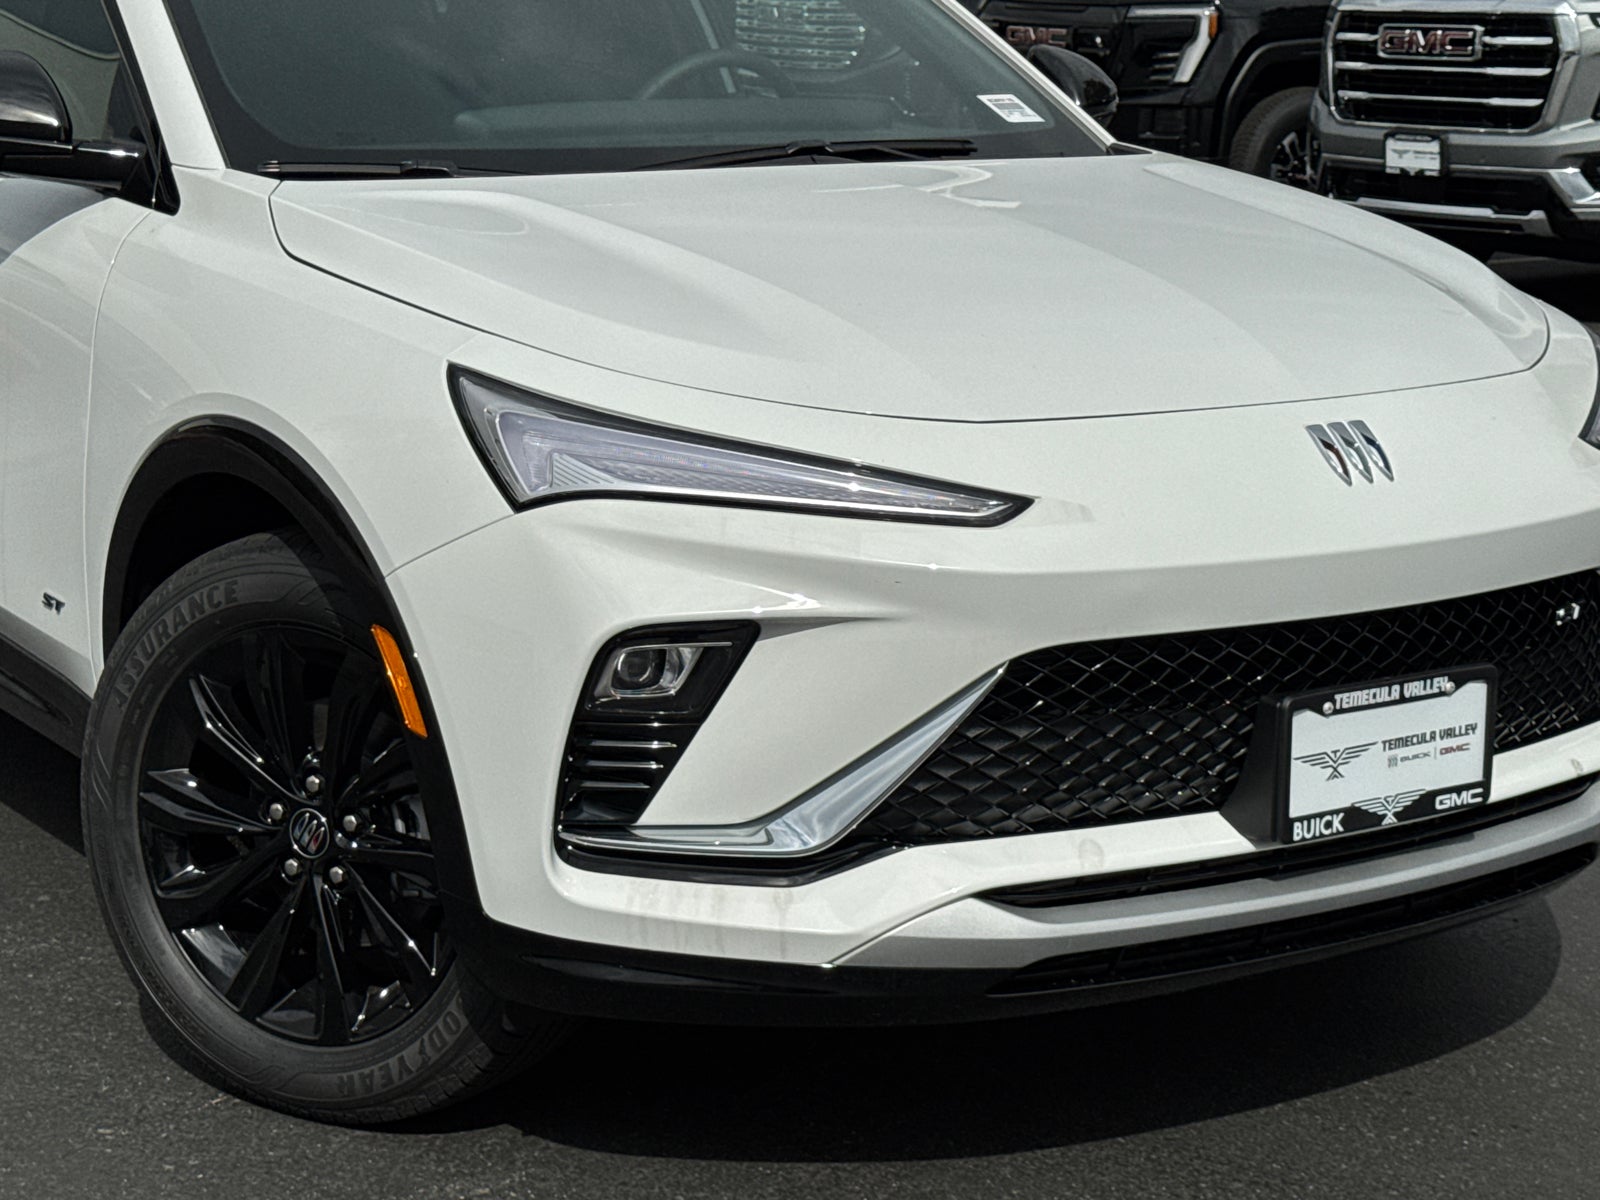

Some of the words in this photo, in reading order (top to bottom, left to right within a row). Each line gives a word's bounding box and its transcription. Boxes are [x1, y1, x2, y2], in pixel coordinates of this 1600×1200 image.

[1006, 25, 1067, 46] GMC
[1381, 29, 1473, 54] GMC
[115, 580, 239, 708] ASSURANCE
[1334, 685, 1400, 710] TEMECULA
[1403, 676, 1449, 699] VALLEY
[1381, 730, 1437, 752] TEMECULA
[1439, 722, 1478, 742] VALLEY
[1400, 751, 1432, 763] BUICK
[1439, 742, 1471, 756] GMC
[1434, 788, 1484, 811] GMC
[1293, 812, 1345, 842] BUICK
